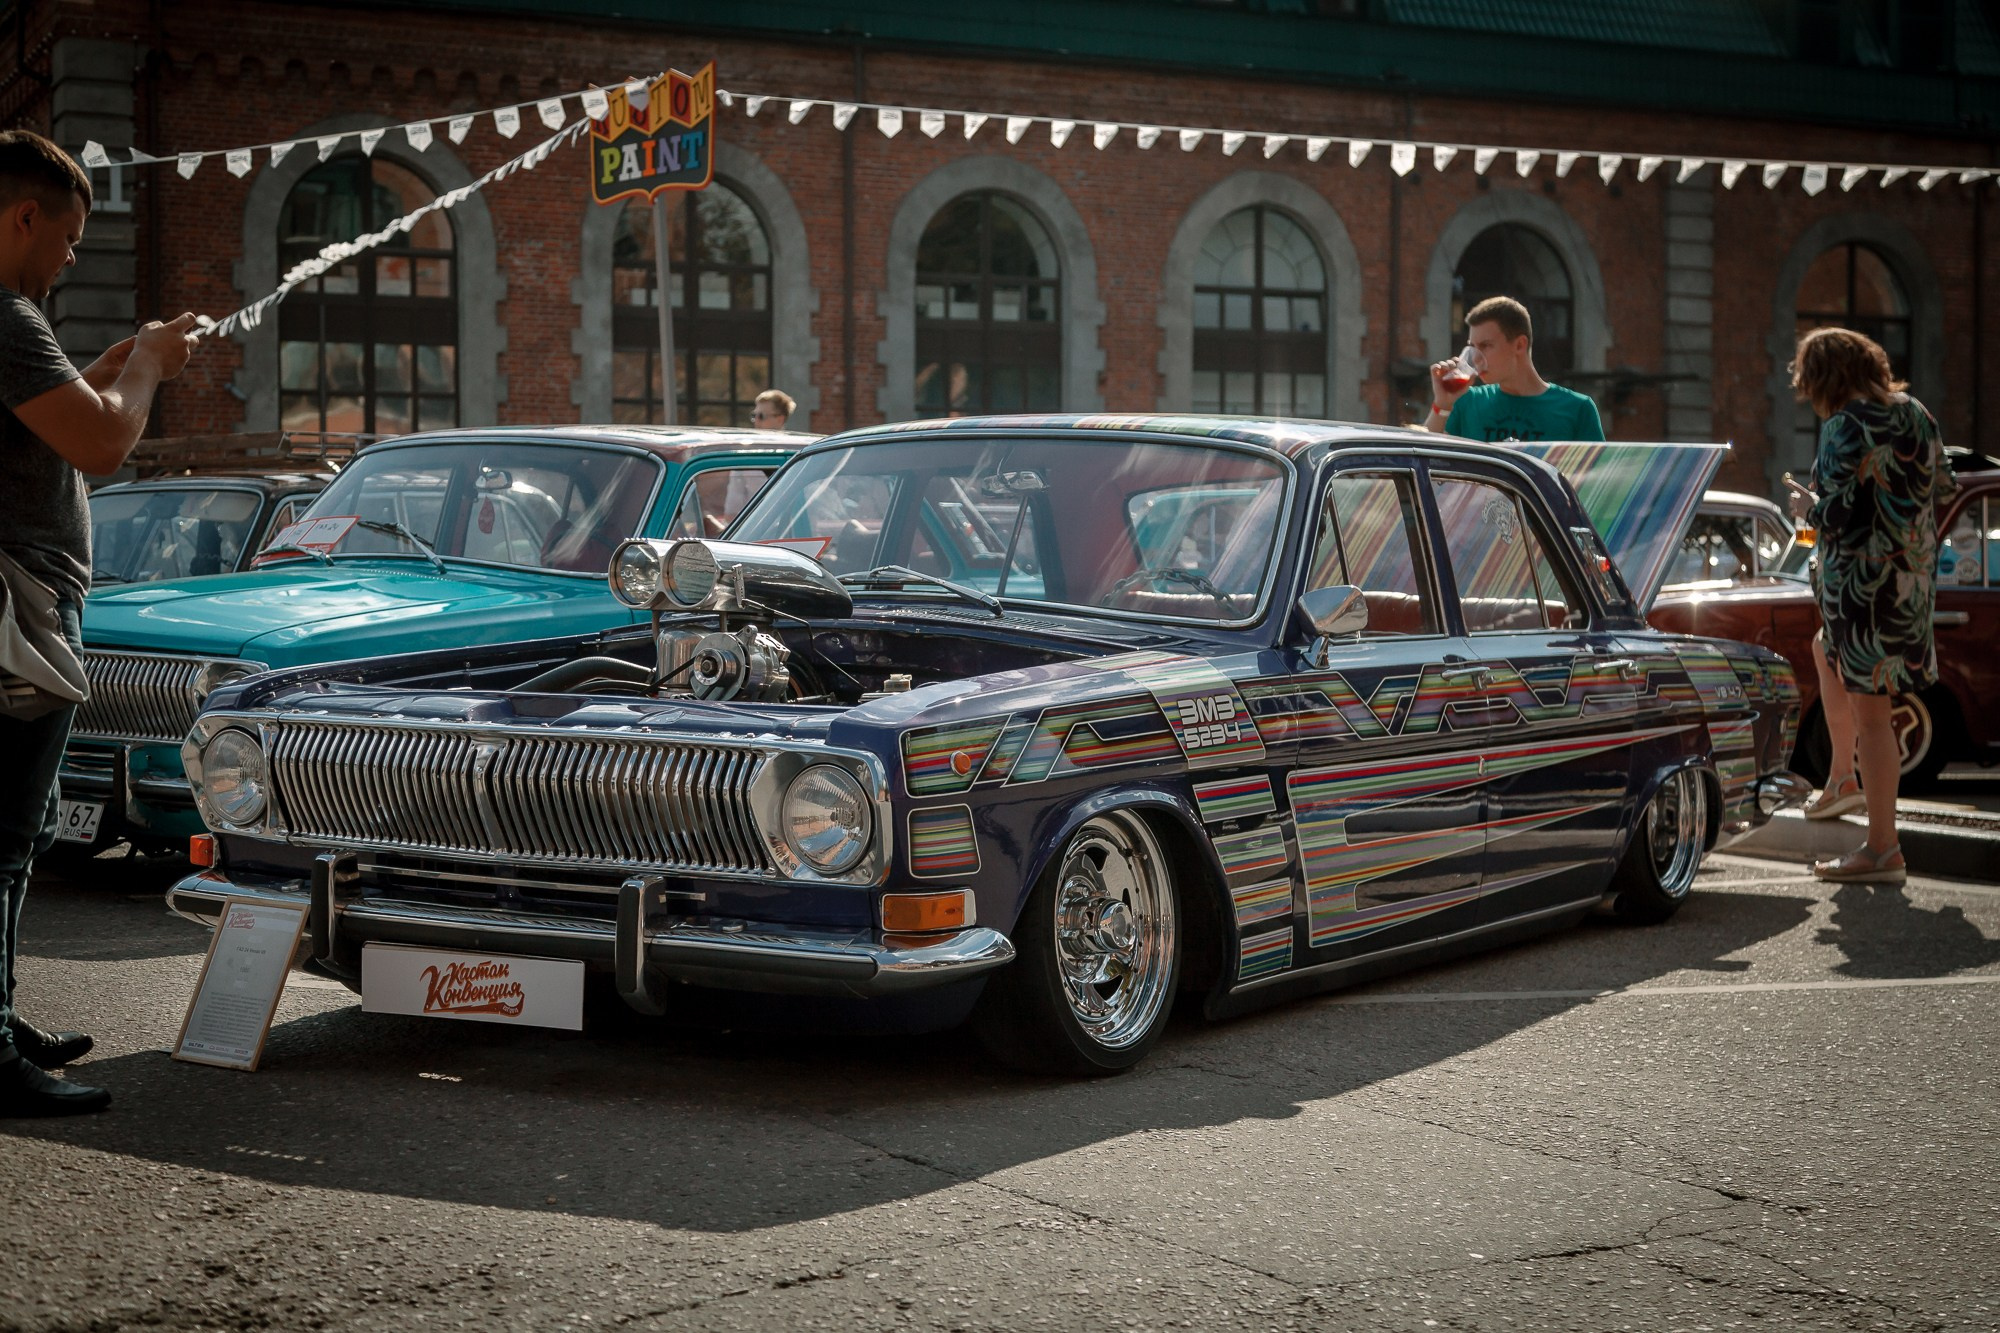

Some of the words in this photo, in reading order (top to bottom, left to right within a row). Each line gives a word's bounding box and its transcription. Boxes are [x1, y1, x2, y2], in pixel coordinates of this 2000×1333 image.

[600, 131, 704, 184] PAINT
[1183, 721, 1242, 749] 5234
[69, 804, 95, 829] 67
[63, 828, 81, 838] RUS
[419, 965, 523, 1012] Конвенция
[446, 960, 510, 989] Кастом
